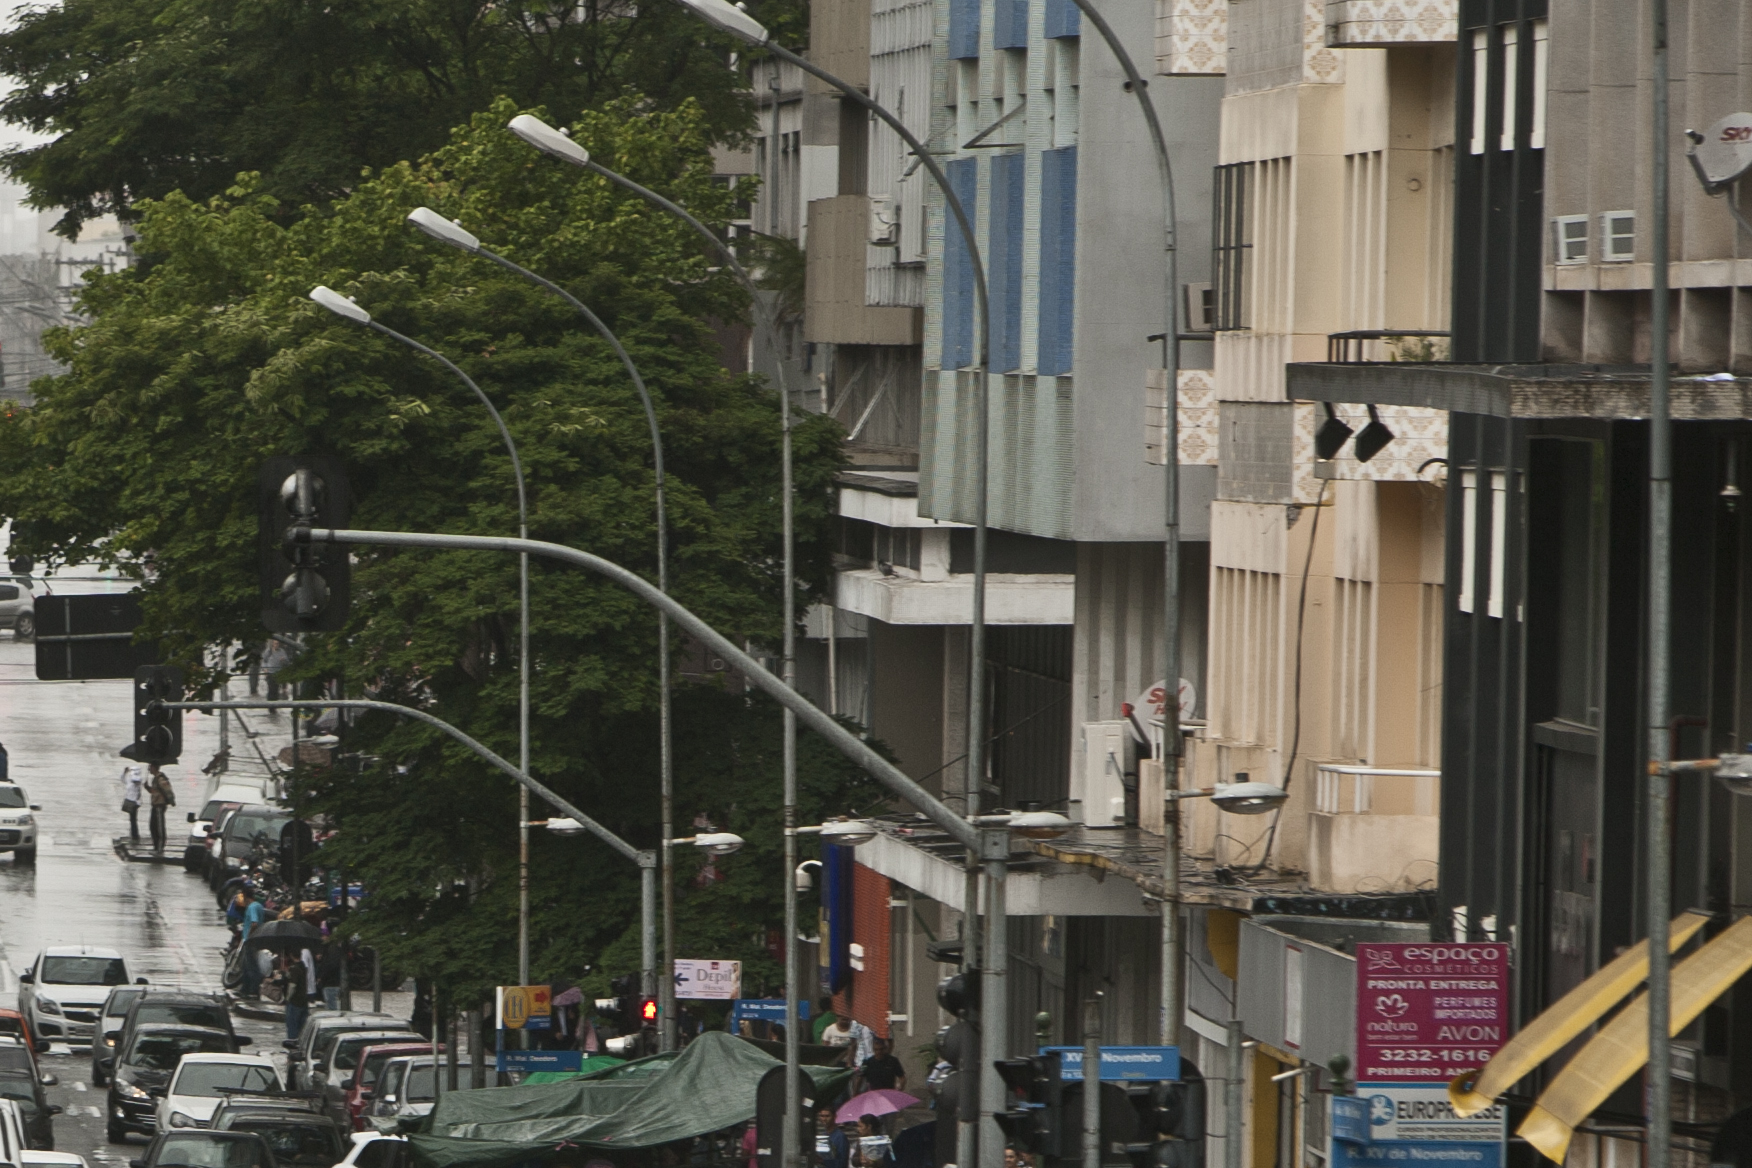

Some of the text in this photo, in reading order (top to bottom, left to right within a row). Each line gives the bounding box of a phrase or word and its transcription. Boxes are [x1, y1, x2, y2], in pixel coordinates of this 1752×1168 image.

[1403, 947, 1499, 964] espaço
[1367, 980, 1499, 989] PRONTA ENTREGA
[1434, 997, 1497, 1007] PERFUMES
[1434, 1009, 1497, 1020] IMPORTADOS
[1367, 1019, 1419, 1032] natura
[1437, 1025, 1500, 1041] AVON
[1101, 1052, 1163, 1063] Novembro
[1379, 1049, 1491, 1061] 3232-1616
[1367, 1067, 1441, 1076] PRIMEIRO
[1367, 1148, 1385, 1160] XV
[1388, 1147, 1407, 1160] de
[1409, 1147, 1484, 1161] Novembro
